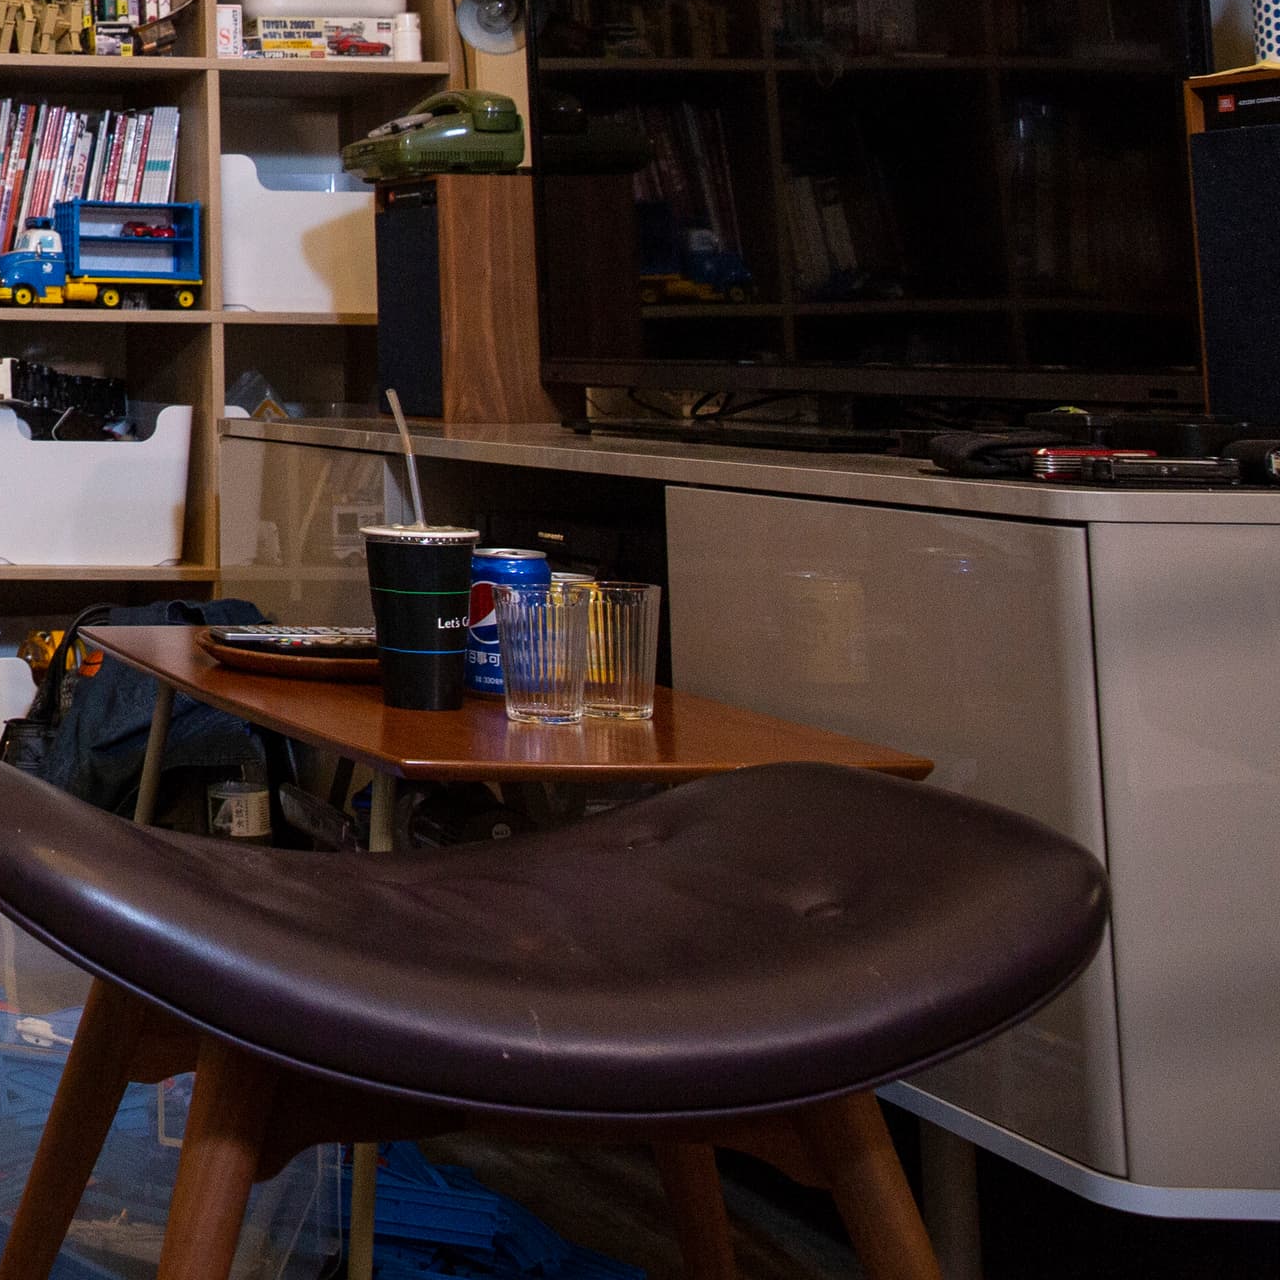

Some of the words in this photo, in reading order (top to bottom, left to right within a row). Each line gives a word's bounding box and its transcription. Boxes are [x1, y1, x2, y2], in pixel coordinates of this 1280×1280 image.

[262, 20, 288, 30] TOYOTA
[290, 20, 315, 30] 2000GT
[437, 617, 460, 629] Let's
